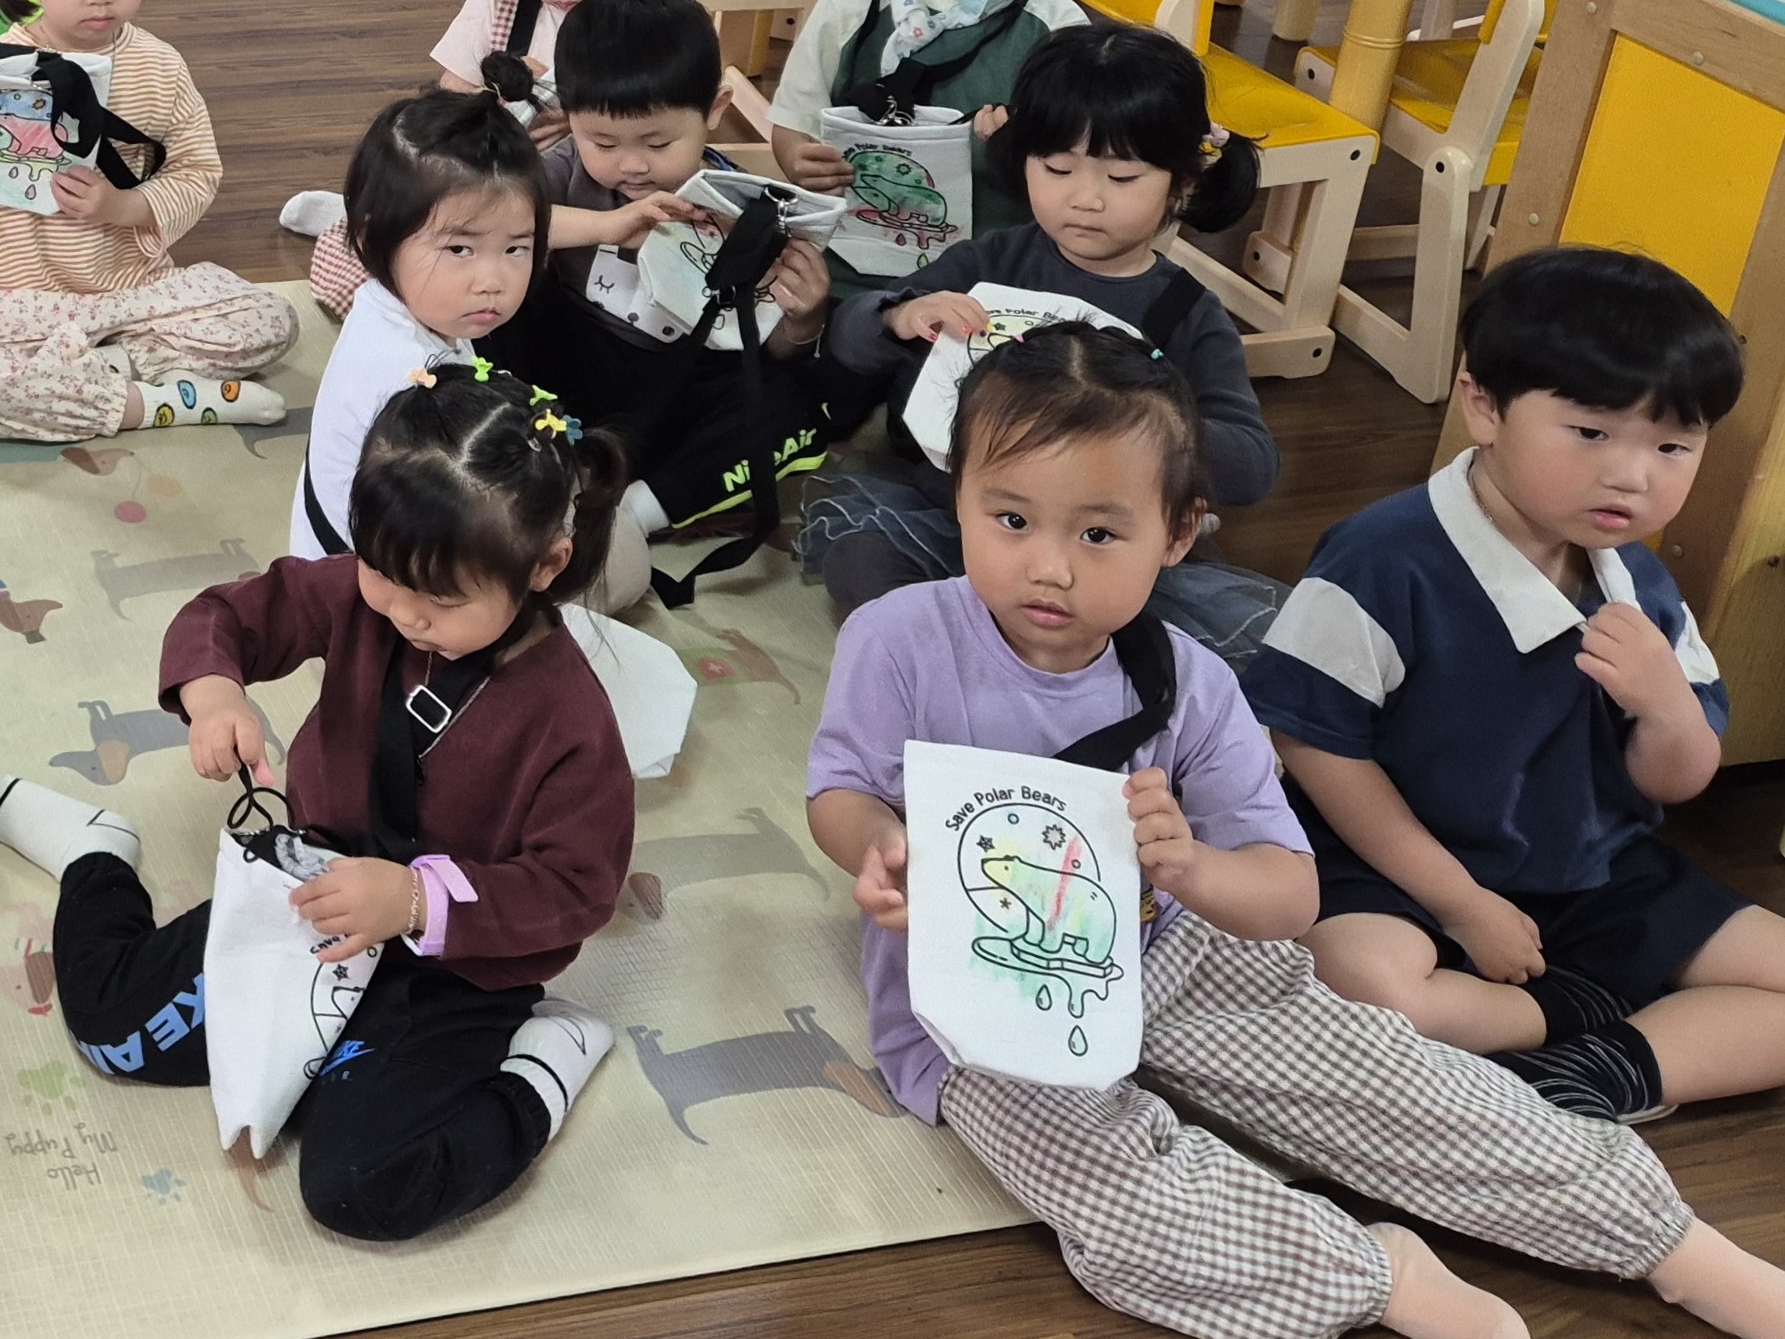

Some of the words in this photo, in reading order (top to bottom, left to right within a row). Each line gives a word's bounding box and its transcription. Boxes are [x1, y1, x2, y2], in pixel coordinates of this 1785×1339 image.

[1005, 308, 1040, 317] Polar
[945, 802, 975, 831] Save
[974, 788, 1014, 806] Polar
[1021, 786, 1067, 811] Bears
[3, 1129, 76, 1159] Puppy
[73, 1122, 118, 1154] My
[47, 1162, 102, 1191] Hello
